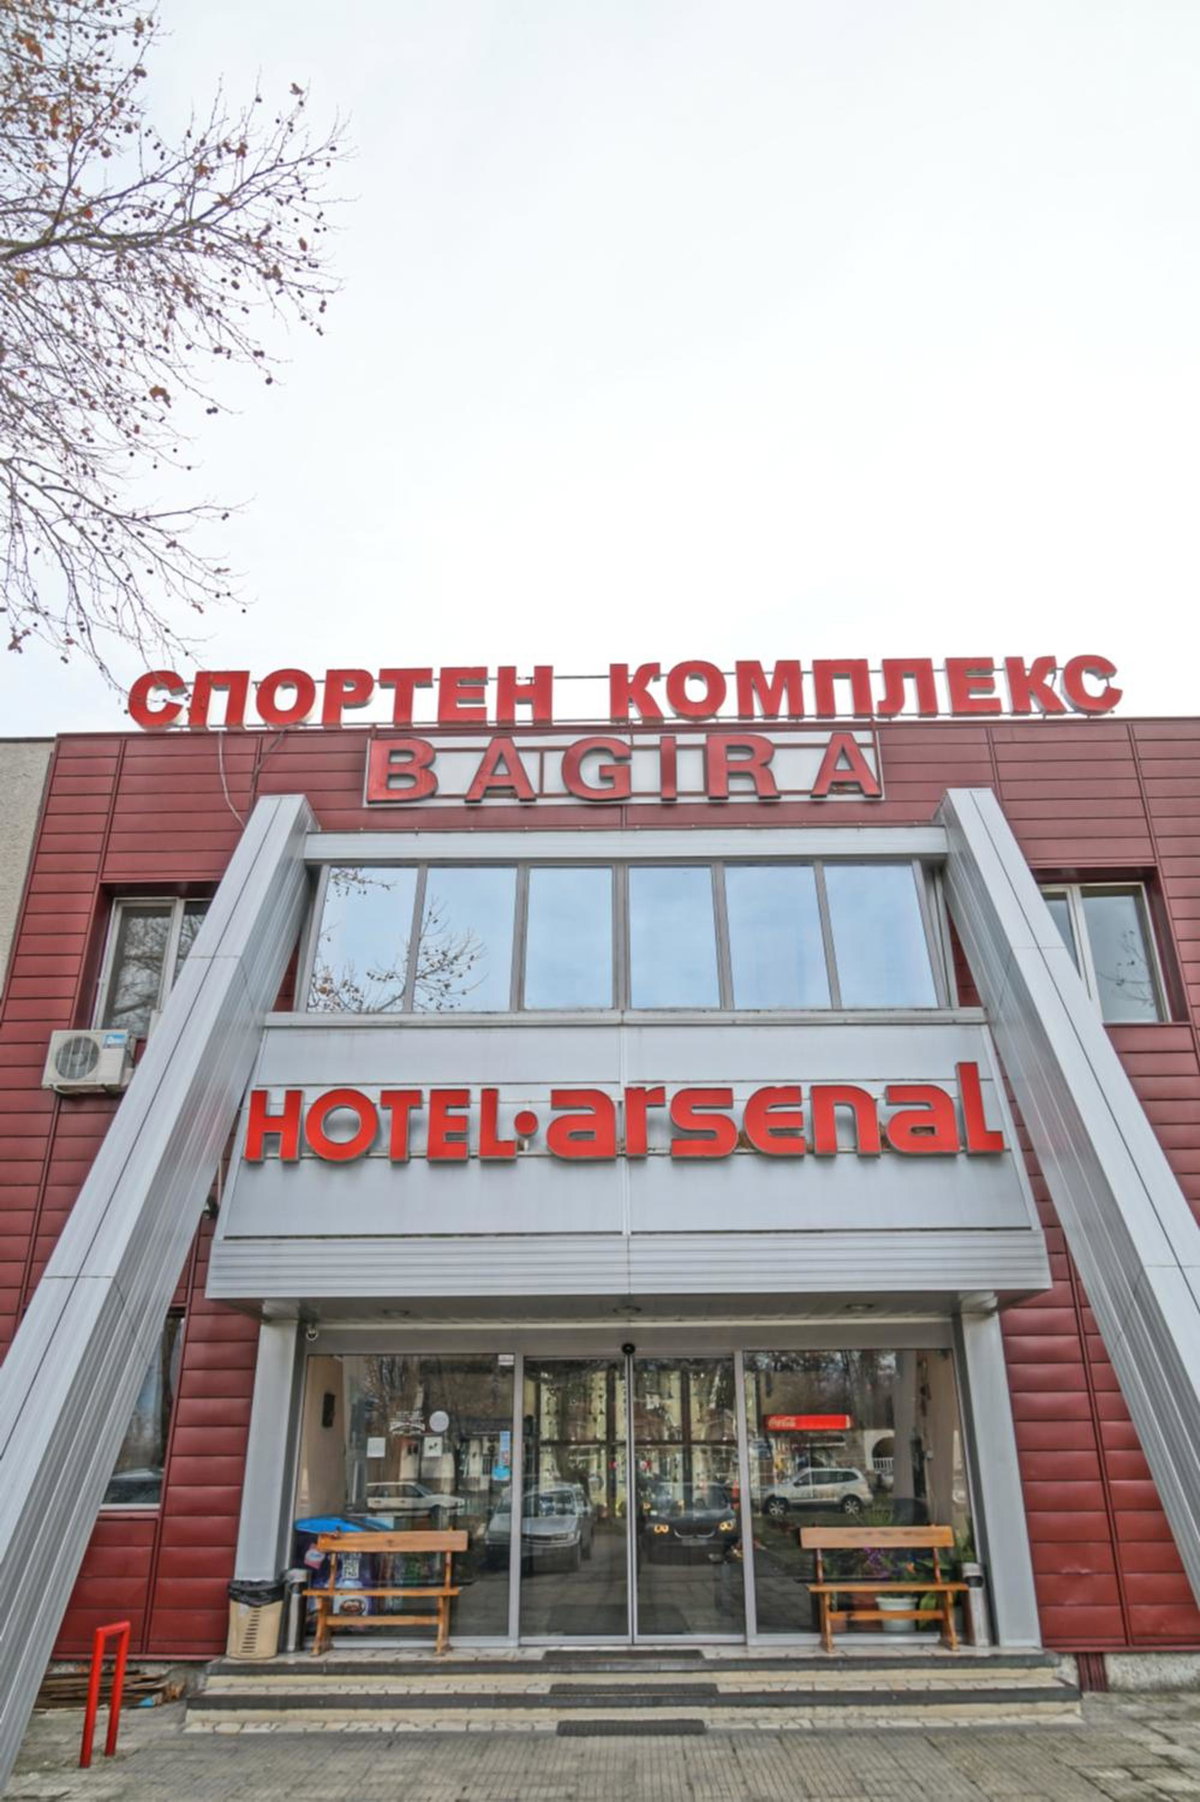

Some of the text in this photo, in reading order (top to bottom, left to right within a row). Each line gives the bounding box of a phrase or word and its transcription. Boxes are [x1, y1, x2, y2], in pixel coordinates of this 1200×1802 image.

[128, 654, 1123, 731] СПОРТЕН КОМПЛЕКС
[366, 731, 882, 803] BAGIRA
[244, 1061, 1005, 1163] HOTEL arsenal
